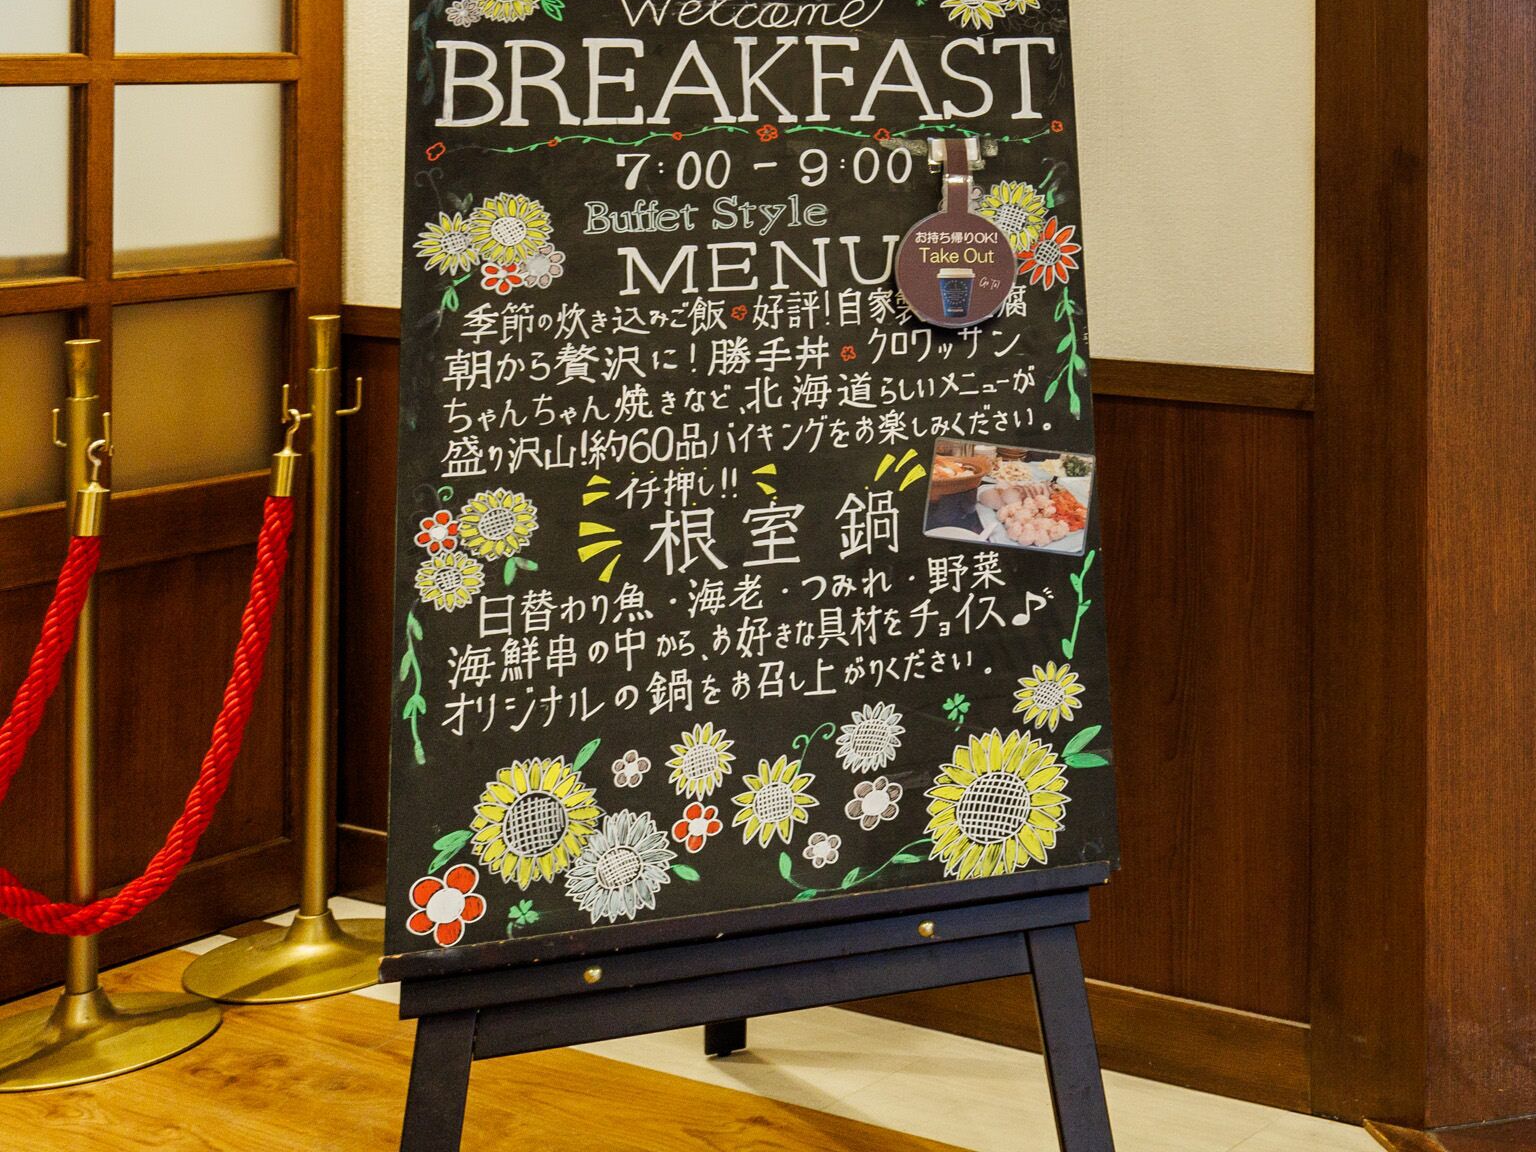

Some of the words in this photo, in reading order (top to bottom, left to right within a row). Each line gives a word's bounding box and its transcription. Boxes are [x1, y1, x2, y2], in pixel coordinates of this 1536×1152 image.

[434, 35, 1056, 127] BREAKFAST
[615, 148, 733, 191] 7:00
[798, 145, 914, 188] 9:00
[583, 198, 699, 236] Buffet
[712, 194, 829, 234] Style
[914, 231, 998, 244] お持ち帰りOK!
[918, 247, 960, 264] Take
[963, 247, 995, 264] Out
[618, 237, 900, 296] MENU
[460, 295, 728, 345] 季節の炊き込みご飯
[867, 327, 1022, 365] クロワッサン
